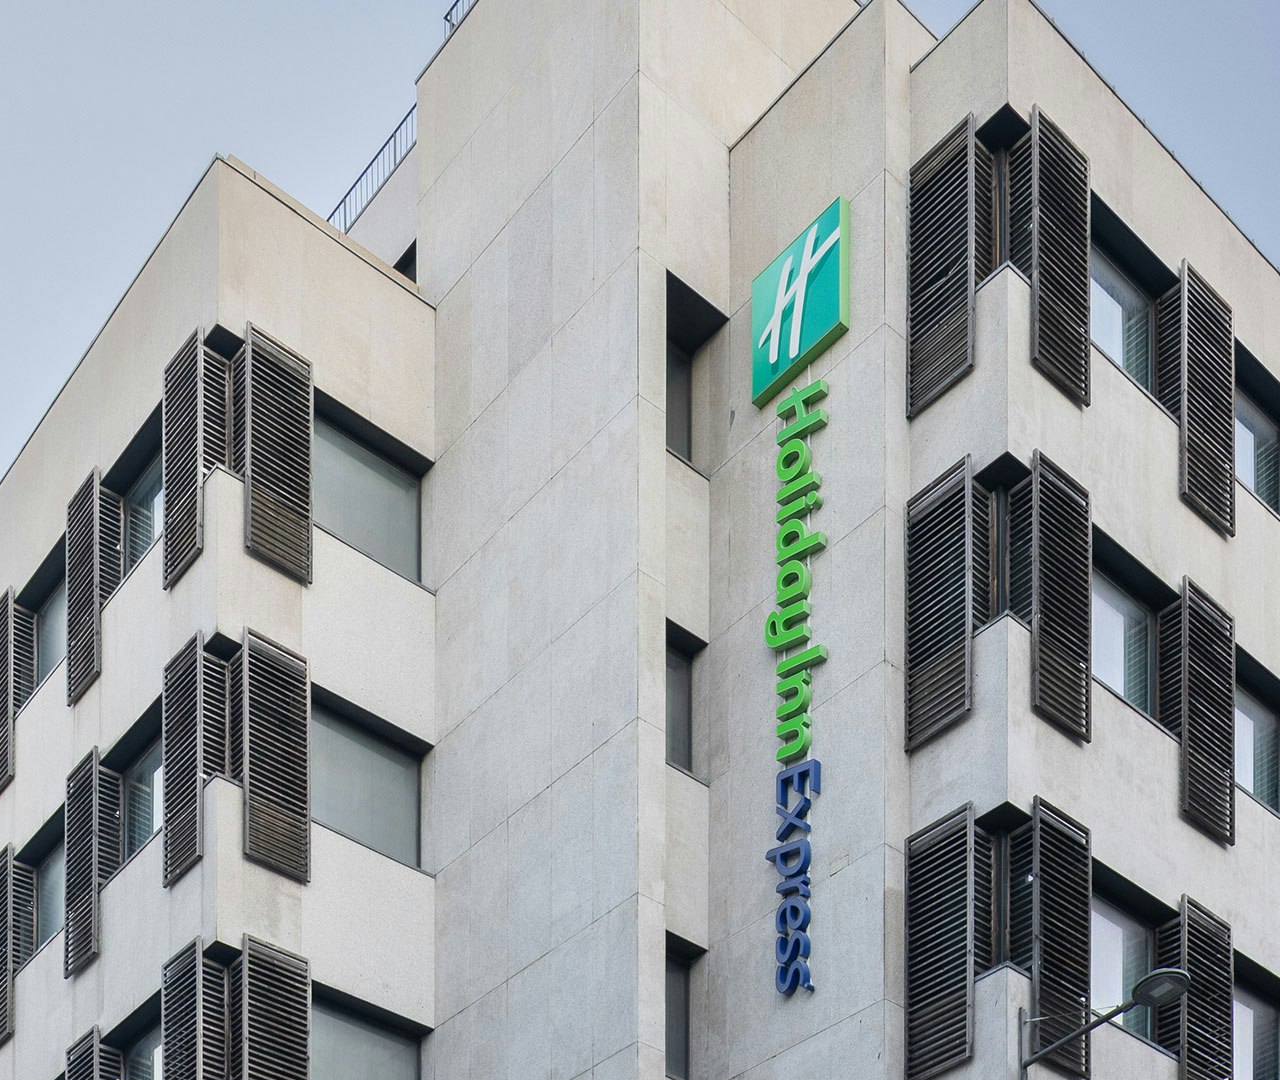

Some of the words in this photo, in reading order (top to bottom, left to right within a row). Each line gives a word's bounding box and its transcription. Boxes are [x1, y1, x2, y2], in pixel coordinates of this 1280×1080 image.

[764, 377, 829, 653] Holiday
[776, 643, 828, 764] Inn
[765, 758, 821, 997] Express
